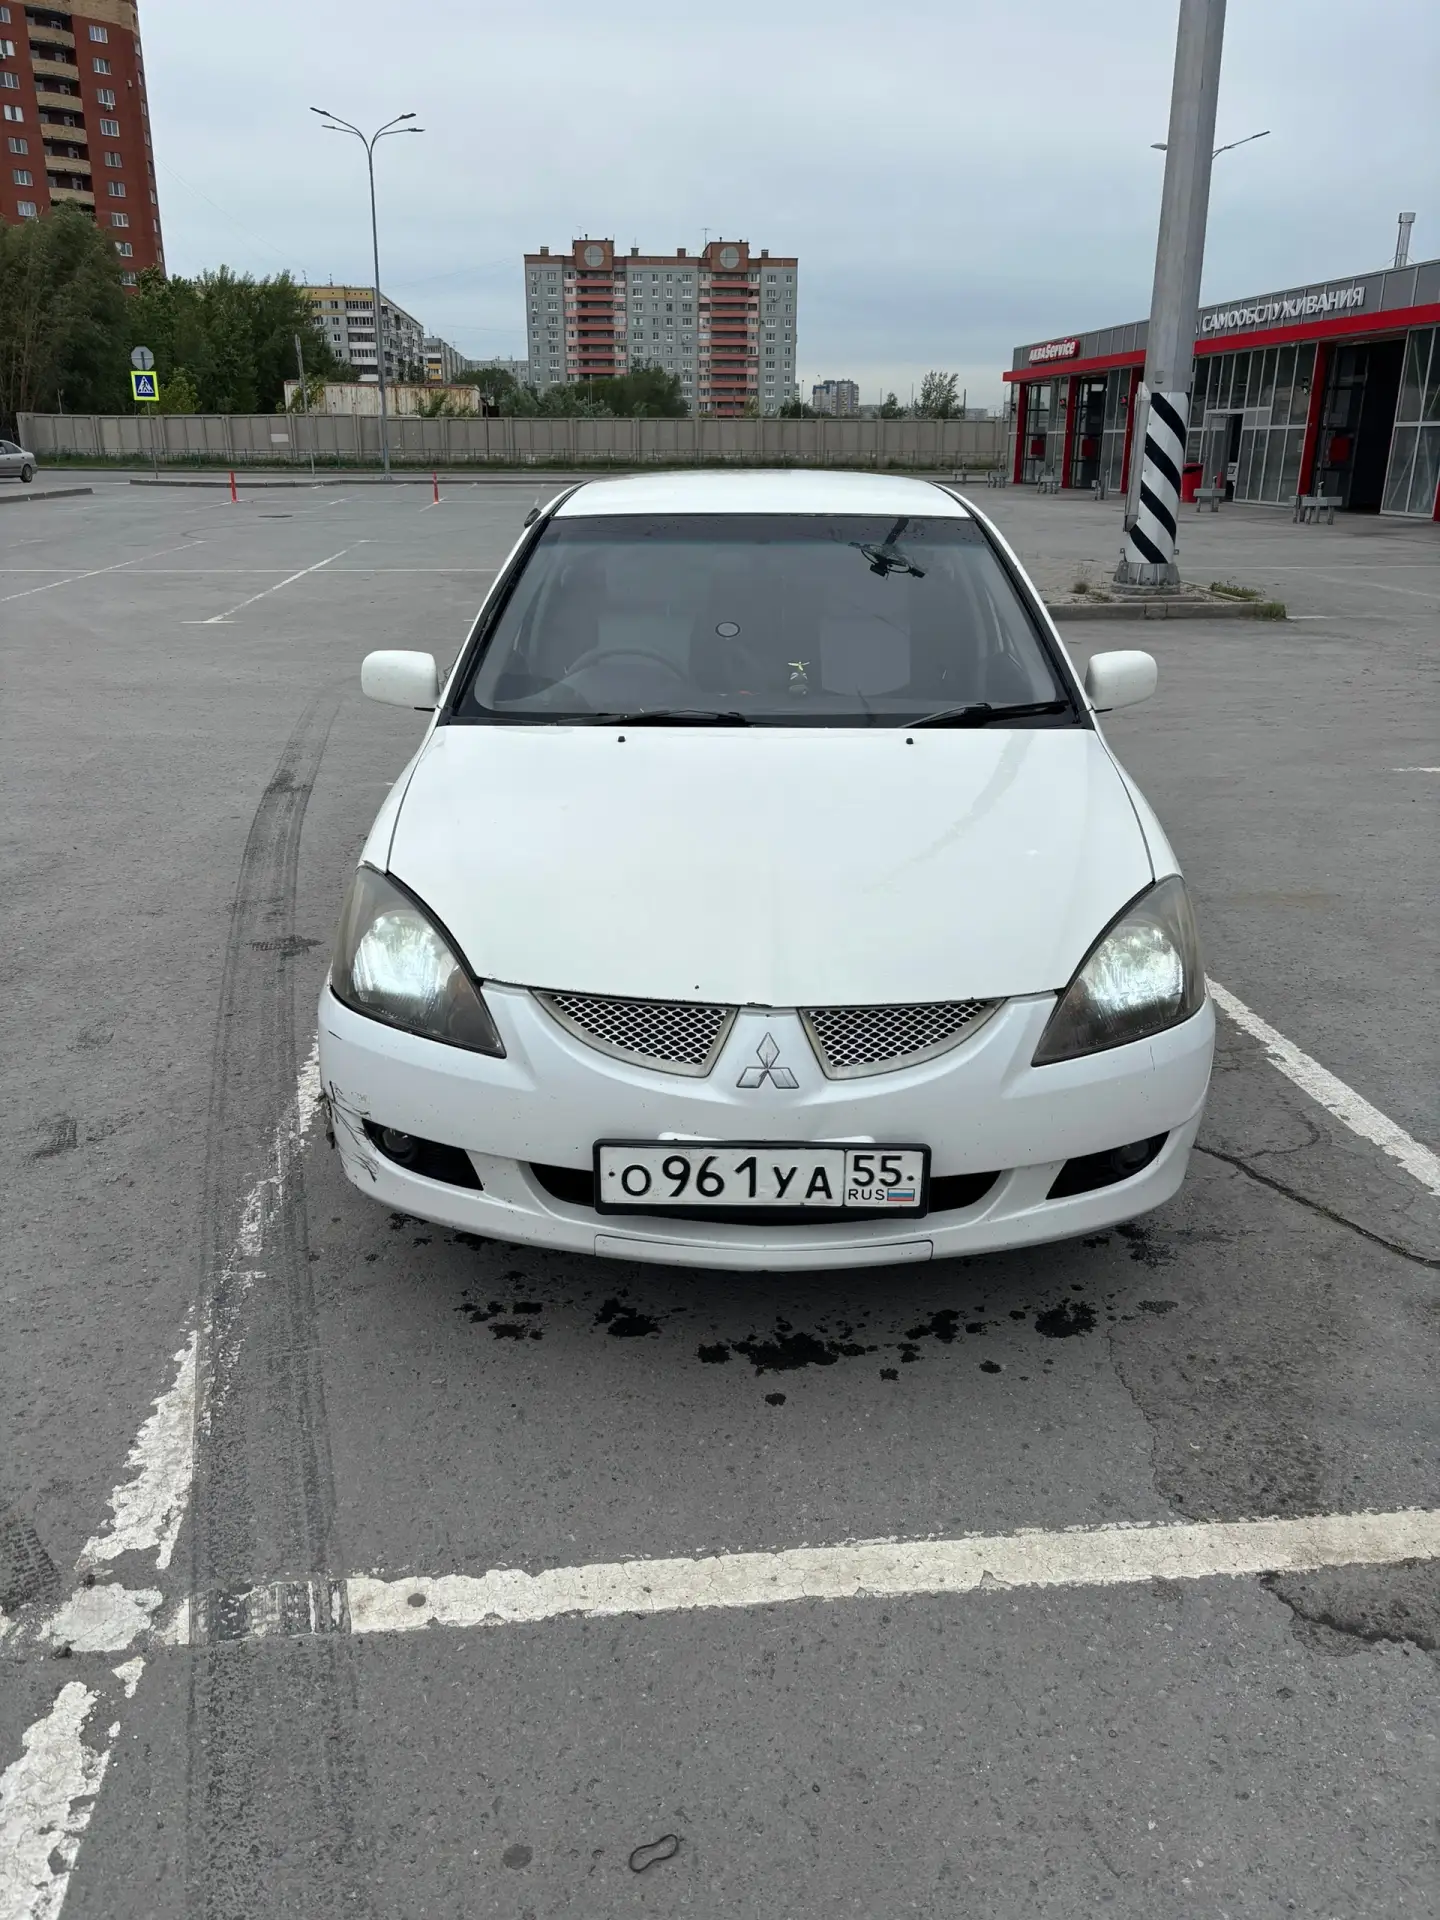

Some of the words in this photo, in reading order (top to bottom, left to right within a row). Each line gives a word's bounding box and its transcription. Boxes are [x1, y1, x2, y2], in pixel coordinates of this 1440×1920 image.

[1202, 286, 1366, 332] САМООБСЛУЖИВАНИЯ
[852, 1154, 902, 1187] 55
[848, 1188, 885, 1201] RUS
